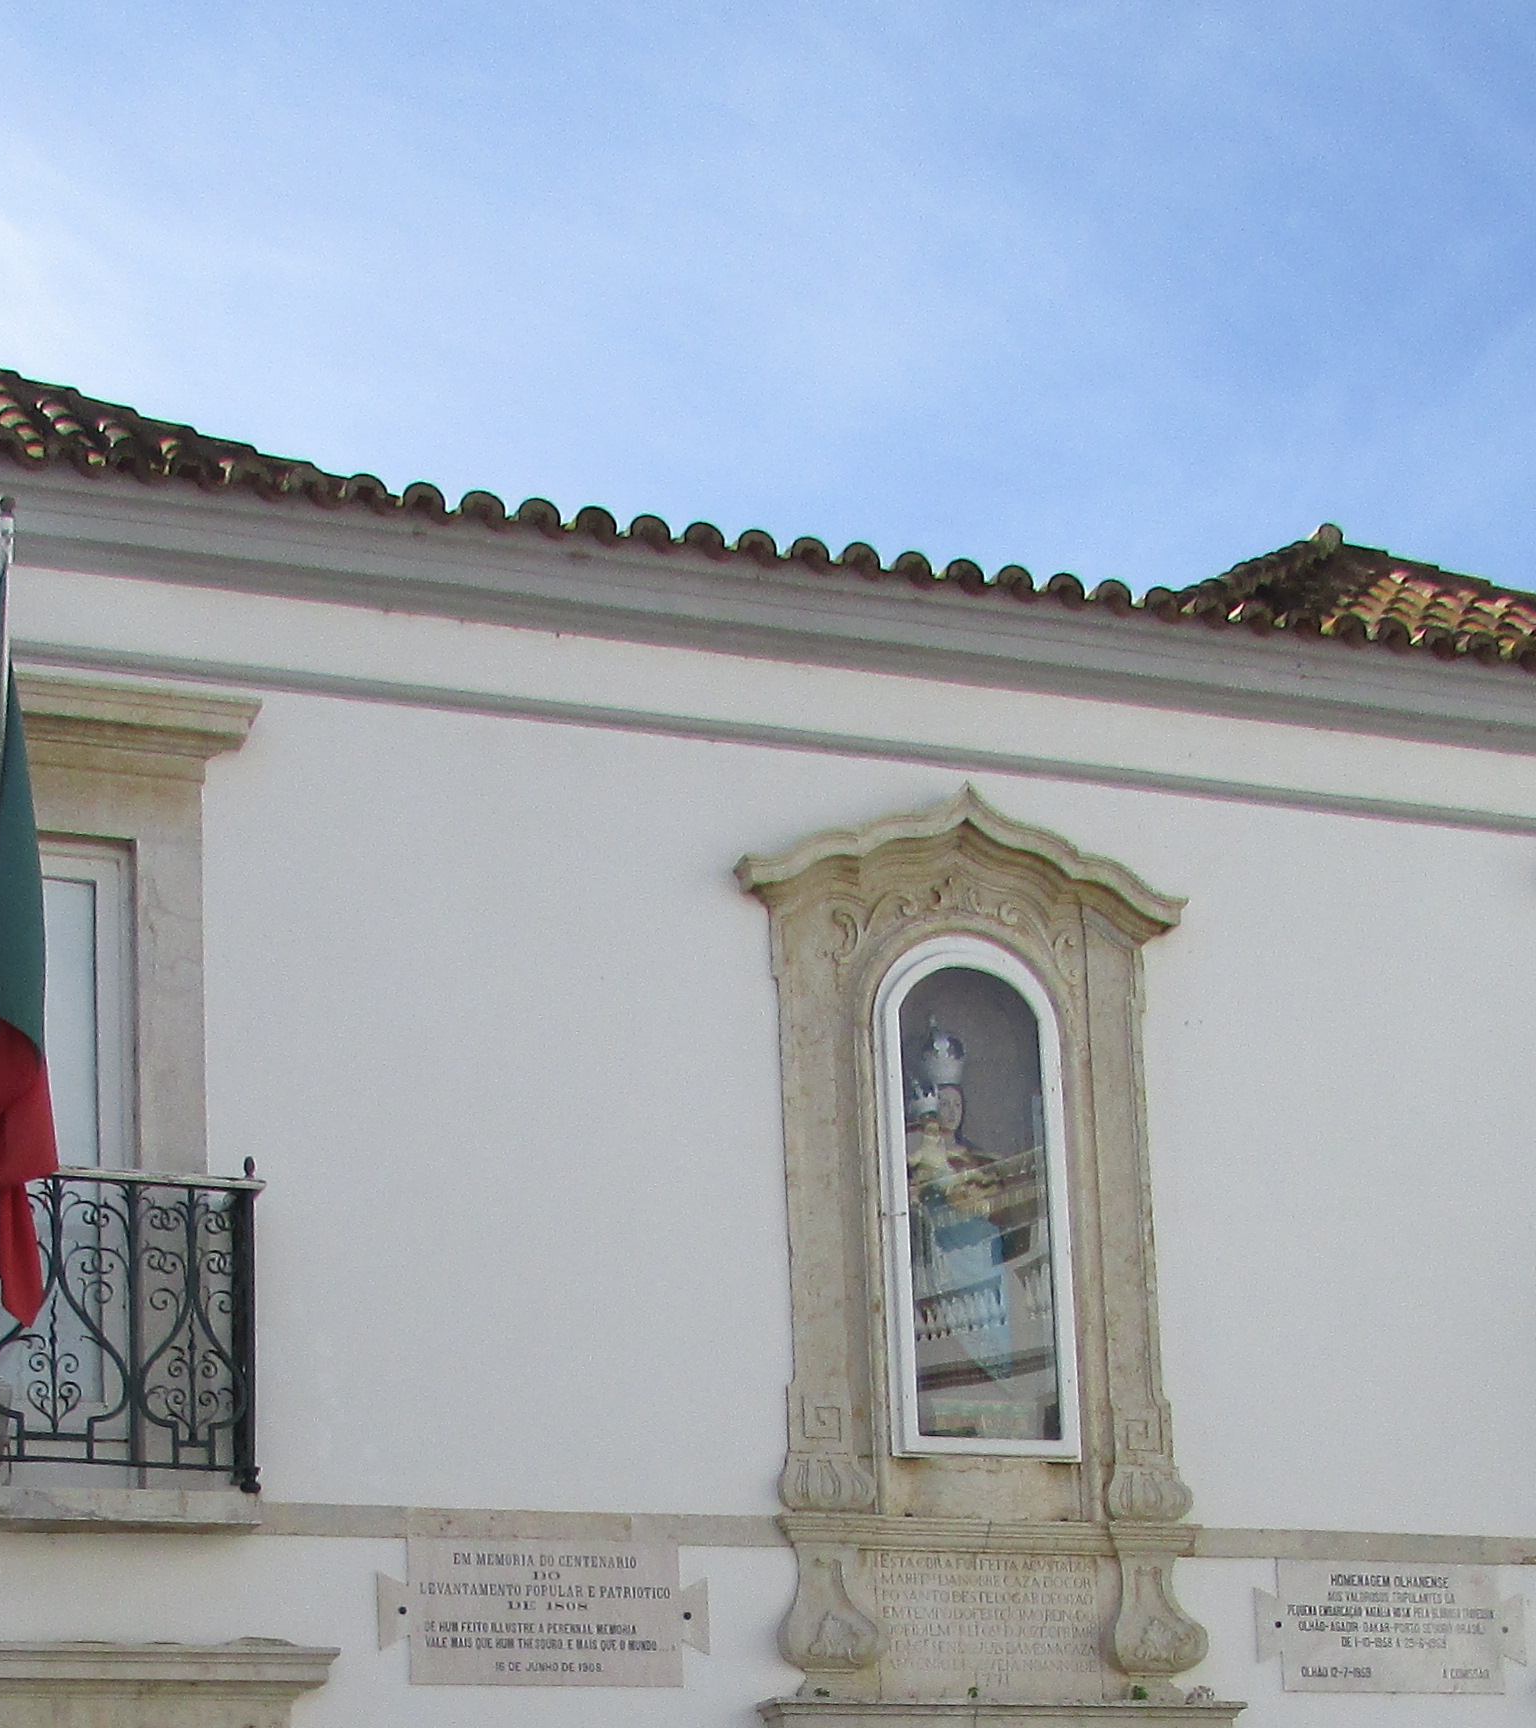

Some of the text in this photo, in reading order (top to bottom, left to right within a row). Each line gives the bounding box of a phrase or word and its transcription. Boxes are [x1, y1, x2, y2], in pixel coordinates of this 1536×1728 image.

[453, 1552, 637, 1569] EM MEMORIA DO CENTENARIO
[533, 1570, 561, 1580] DO
[1330, 1573, 1449, 1589] HOMENAGEM OLHANENSE
[419, 1582, 671, 1599] LEVANTAMENTO POPULAR E PATRIOTICO
[507, 1600, 588, 1611] DE 1808
[461, 1621, 489, 1633] FEITO
[425, 1635, 449, 1648] VALE
[451, 1636, 473, 1648] MAIS
[475, 1637, 492, 1650] QUE
[567, 1639, 574, 1650] E
[575, 1639, 598, 1650] MAIS
[600, 1639, 617, 1652] QUE
[1340, 1636, 1352, 1648] DE
[495, 1661, 506, 1672] 16
[508, 1662, 521, 1672] DE
[525, 1662, 559, 1672] JUNHO
[561, 1662, 576, 1672] DE
